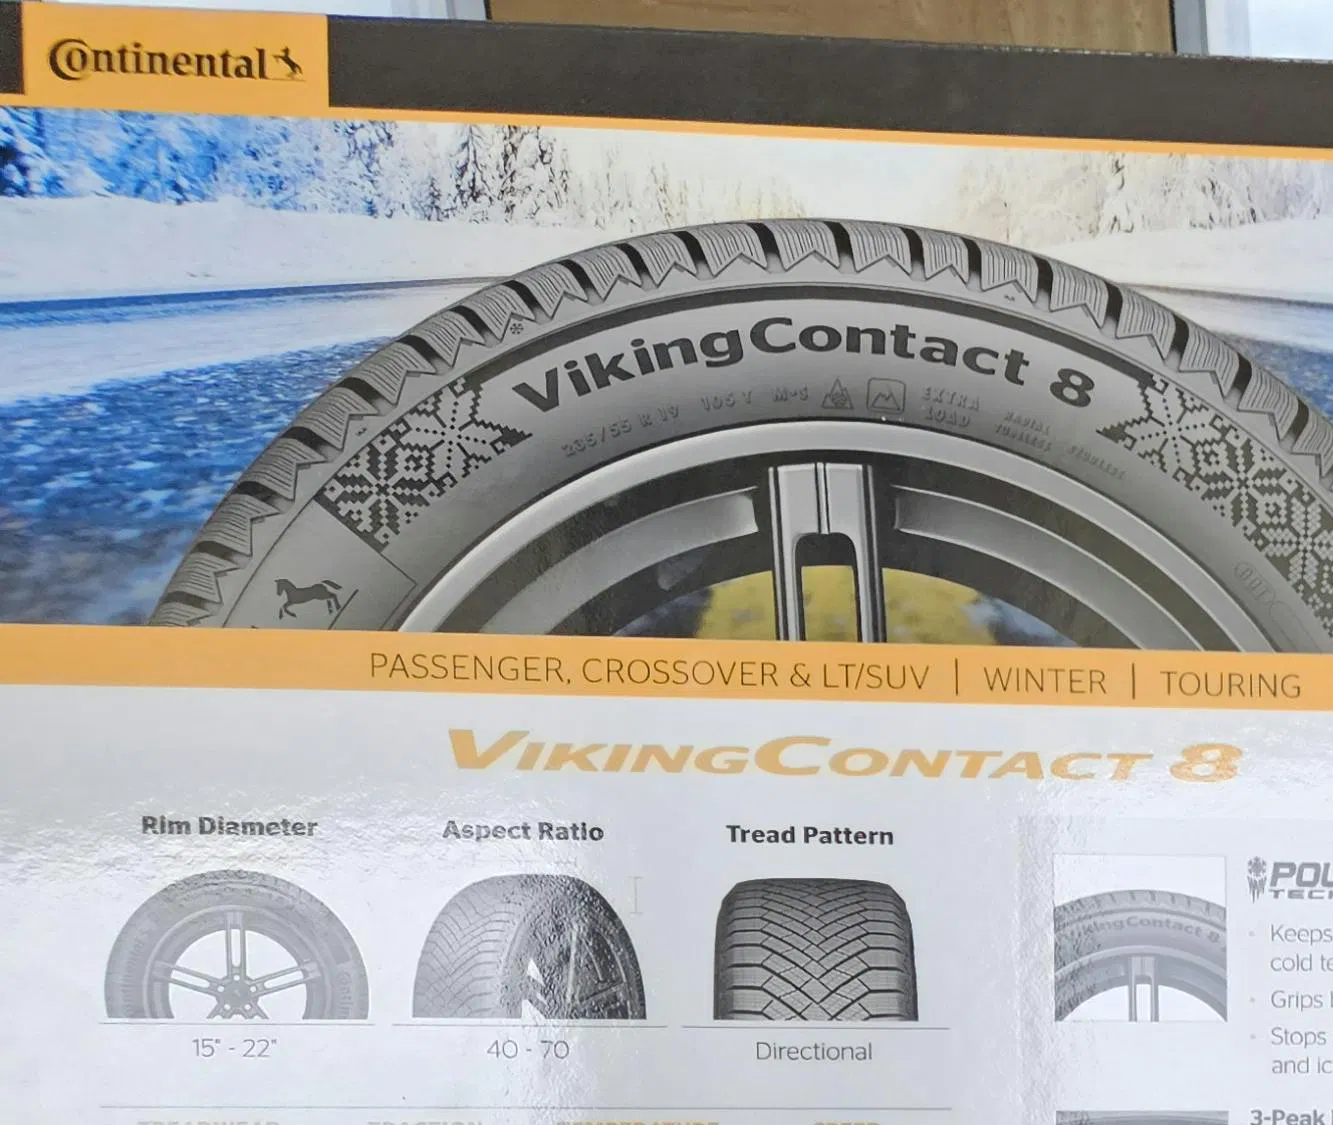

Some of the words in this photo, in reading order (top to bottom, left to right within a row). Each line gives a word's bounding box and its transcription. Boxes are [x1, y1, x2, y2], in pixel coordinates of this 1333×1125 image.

[47, 38, 269, 82] Continental
[512, 316, 1030, 412] VikingContact
[1050, 367, 1095, 408] 8
[920, 385, 981, 413] EXTRA
[924, 407, 972, 428] LOAD
[370, 652, 571, 685] PASSENGER,
[582, 658, 779, 688] CROSSOVER
[789, 662, 812, 688] &
[823, 662, 930, 691] LT/SUV
[983, 666, 1107, 695] WINTER
[1159, 670, 1301, 699] TOURING
[1170, 743, 1241, 784] 8
[141, 815, 192, 836] Rim
[198, 815, 319, 837] Diameter
[441, 820, 532, 844] Aspect
[537, 821, 605, 843] Ratio
[725, 824, 796, 844] Tread
[803, 825, 894, 845] Pattern
[486, 1037, 519, 1060] 40
[539, 1039, 570, 1062] 70
[756, 1040, 873, 1061] Directional
